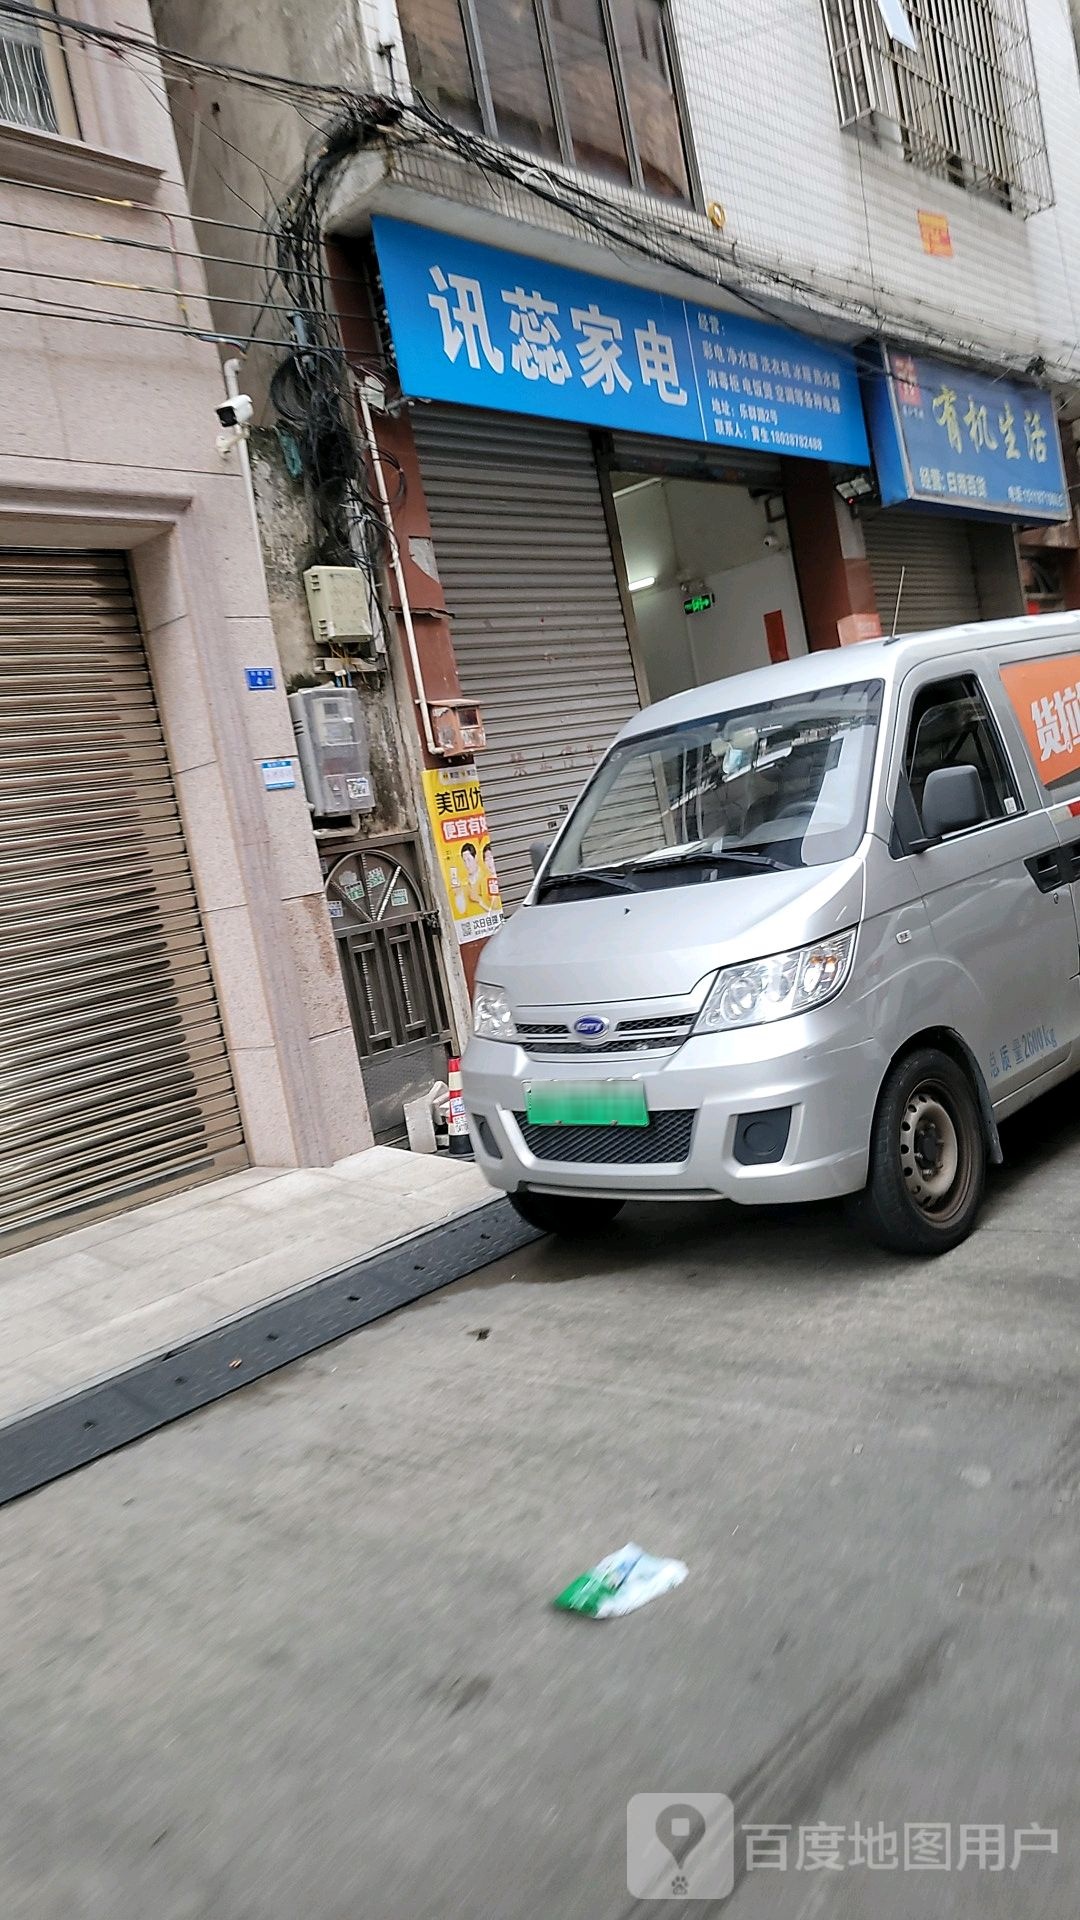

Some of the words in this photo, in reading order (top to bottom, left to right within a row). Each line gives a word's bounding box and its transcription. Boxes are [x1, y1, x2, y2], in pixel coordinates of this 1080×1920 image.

[428, 264, 688, 406] 讯蕊家电
[932, 384, 1047, 463] 有机生活
[1031, 681, 1080, 762] 货拉
